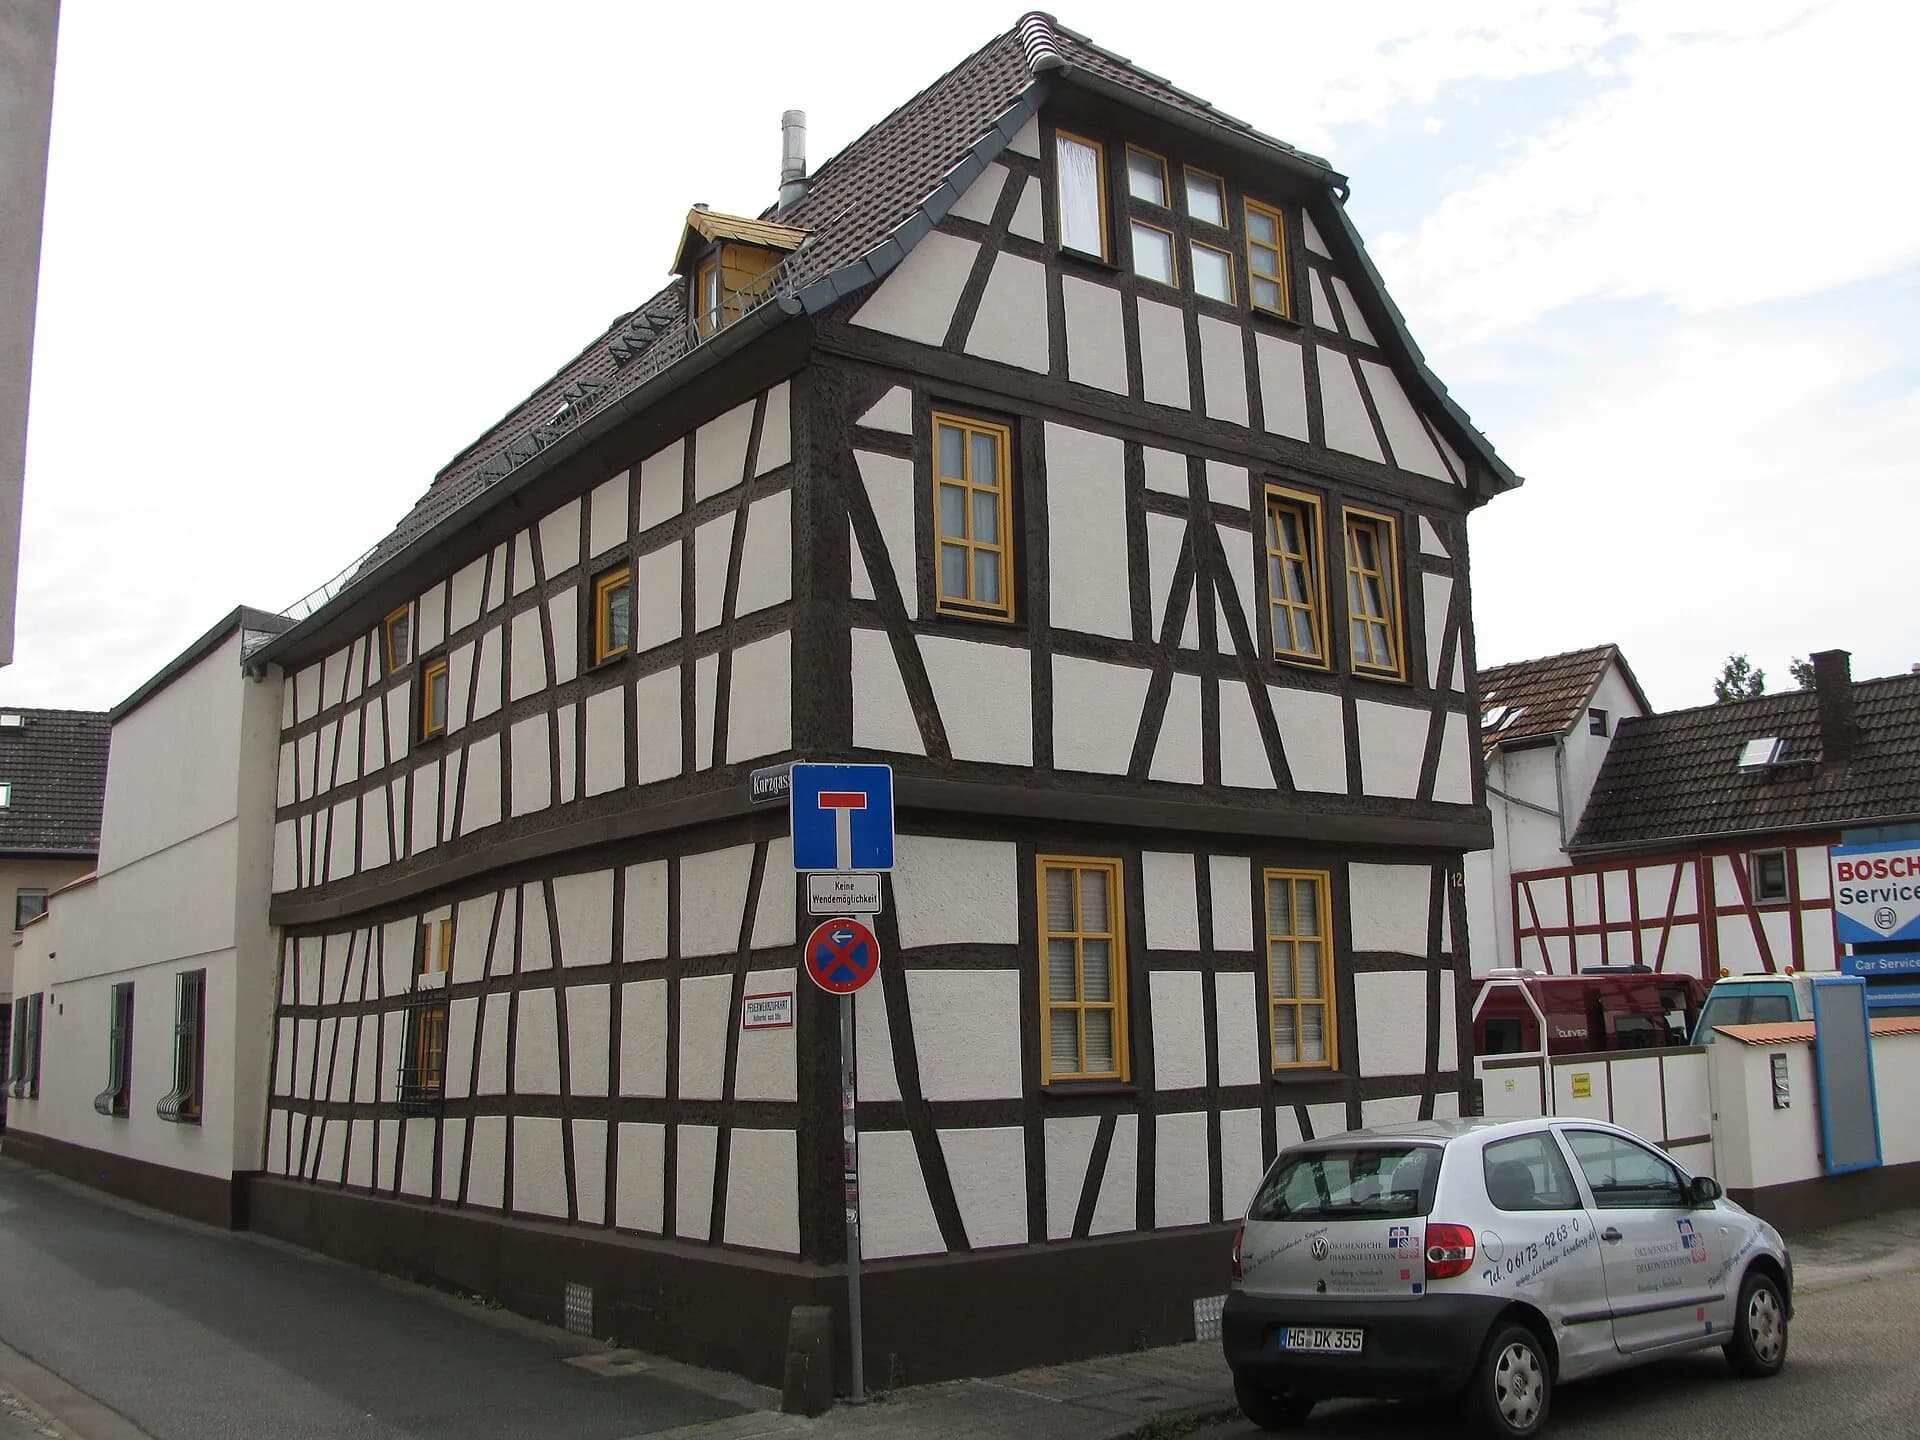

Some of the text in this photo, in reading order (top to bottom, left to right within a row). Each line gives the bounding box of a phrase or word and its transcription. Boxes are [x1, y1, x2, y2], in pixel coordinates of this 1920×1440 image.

[1837, 856, 1920, 881] BOSCH
[834, 881, 855, 891] Keine
[1451, 872, 1462, 887] 12
[812, 894, 877, 906] Wendemöglichkeit
[1839, 882, 1920, 905] Service
[1855, 957, 1920, 970] Car Service
[1558, 1029, 1588, 1038] CLEVER
[1483, 1266, 1506, 1287] Tel.
[1287, 1329, 1362, 1349] HG DK 355
